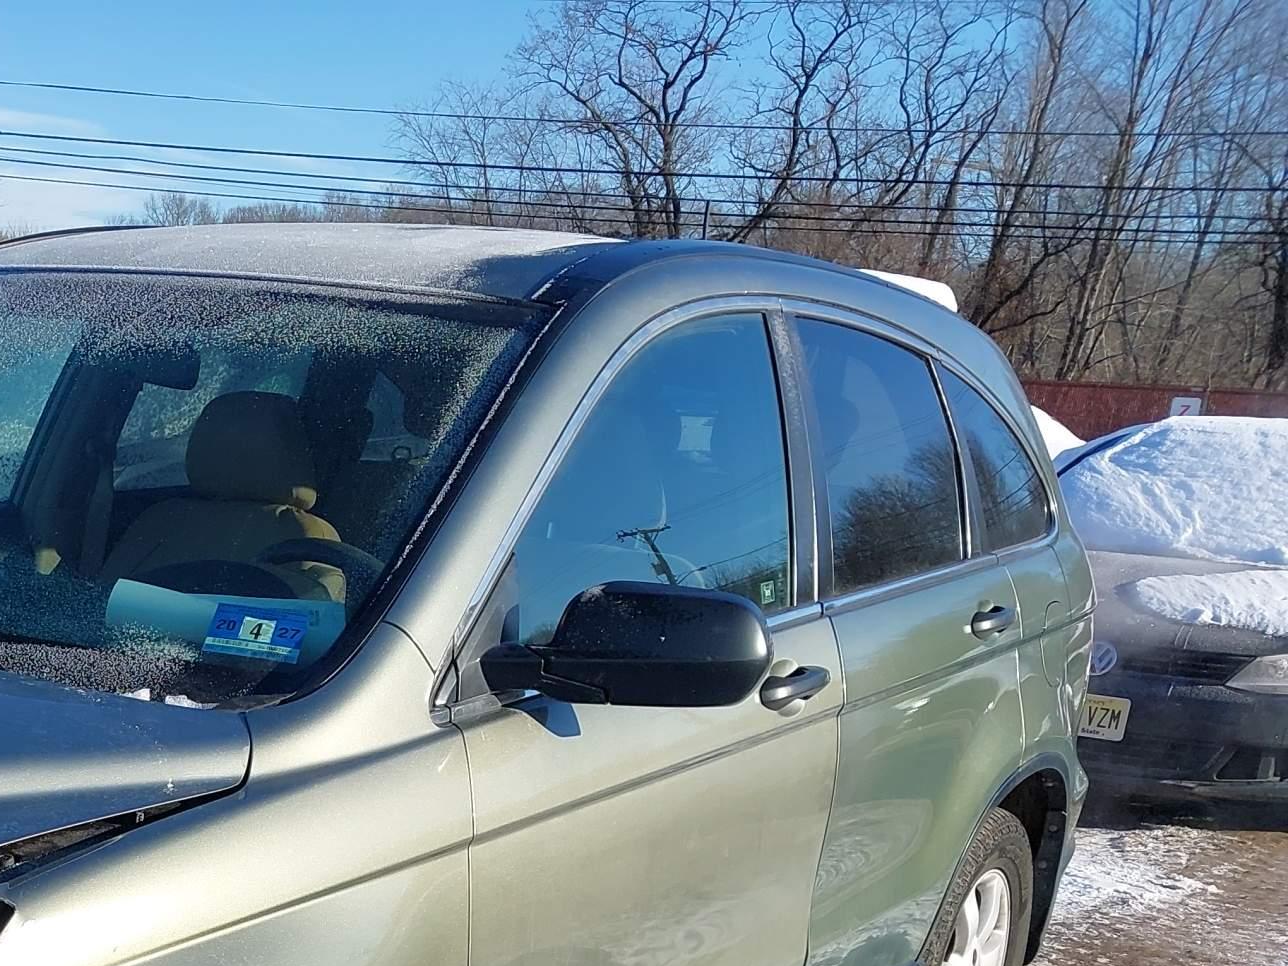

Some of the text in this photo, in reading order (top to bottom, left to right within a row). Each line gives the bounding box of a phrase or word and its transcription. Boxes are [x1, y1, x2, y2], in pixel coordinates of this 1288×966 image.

[215, 618, 301, 640] 20 4 27
[1088, 705, 1122, 730] VZM
